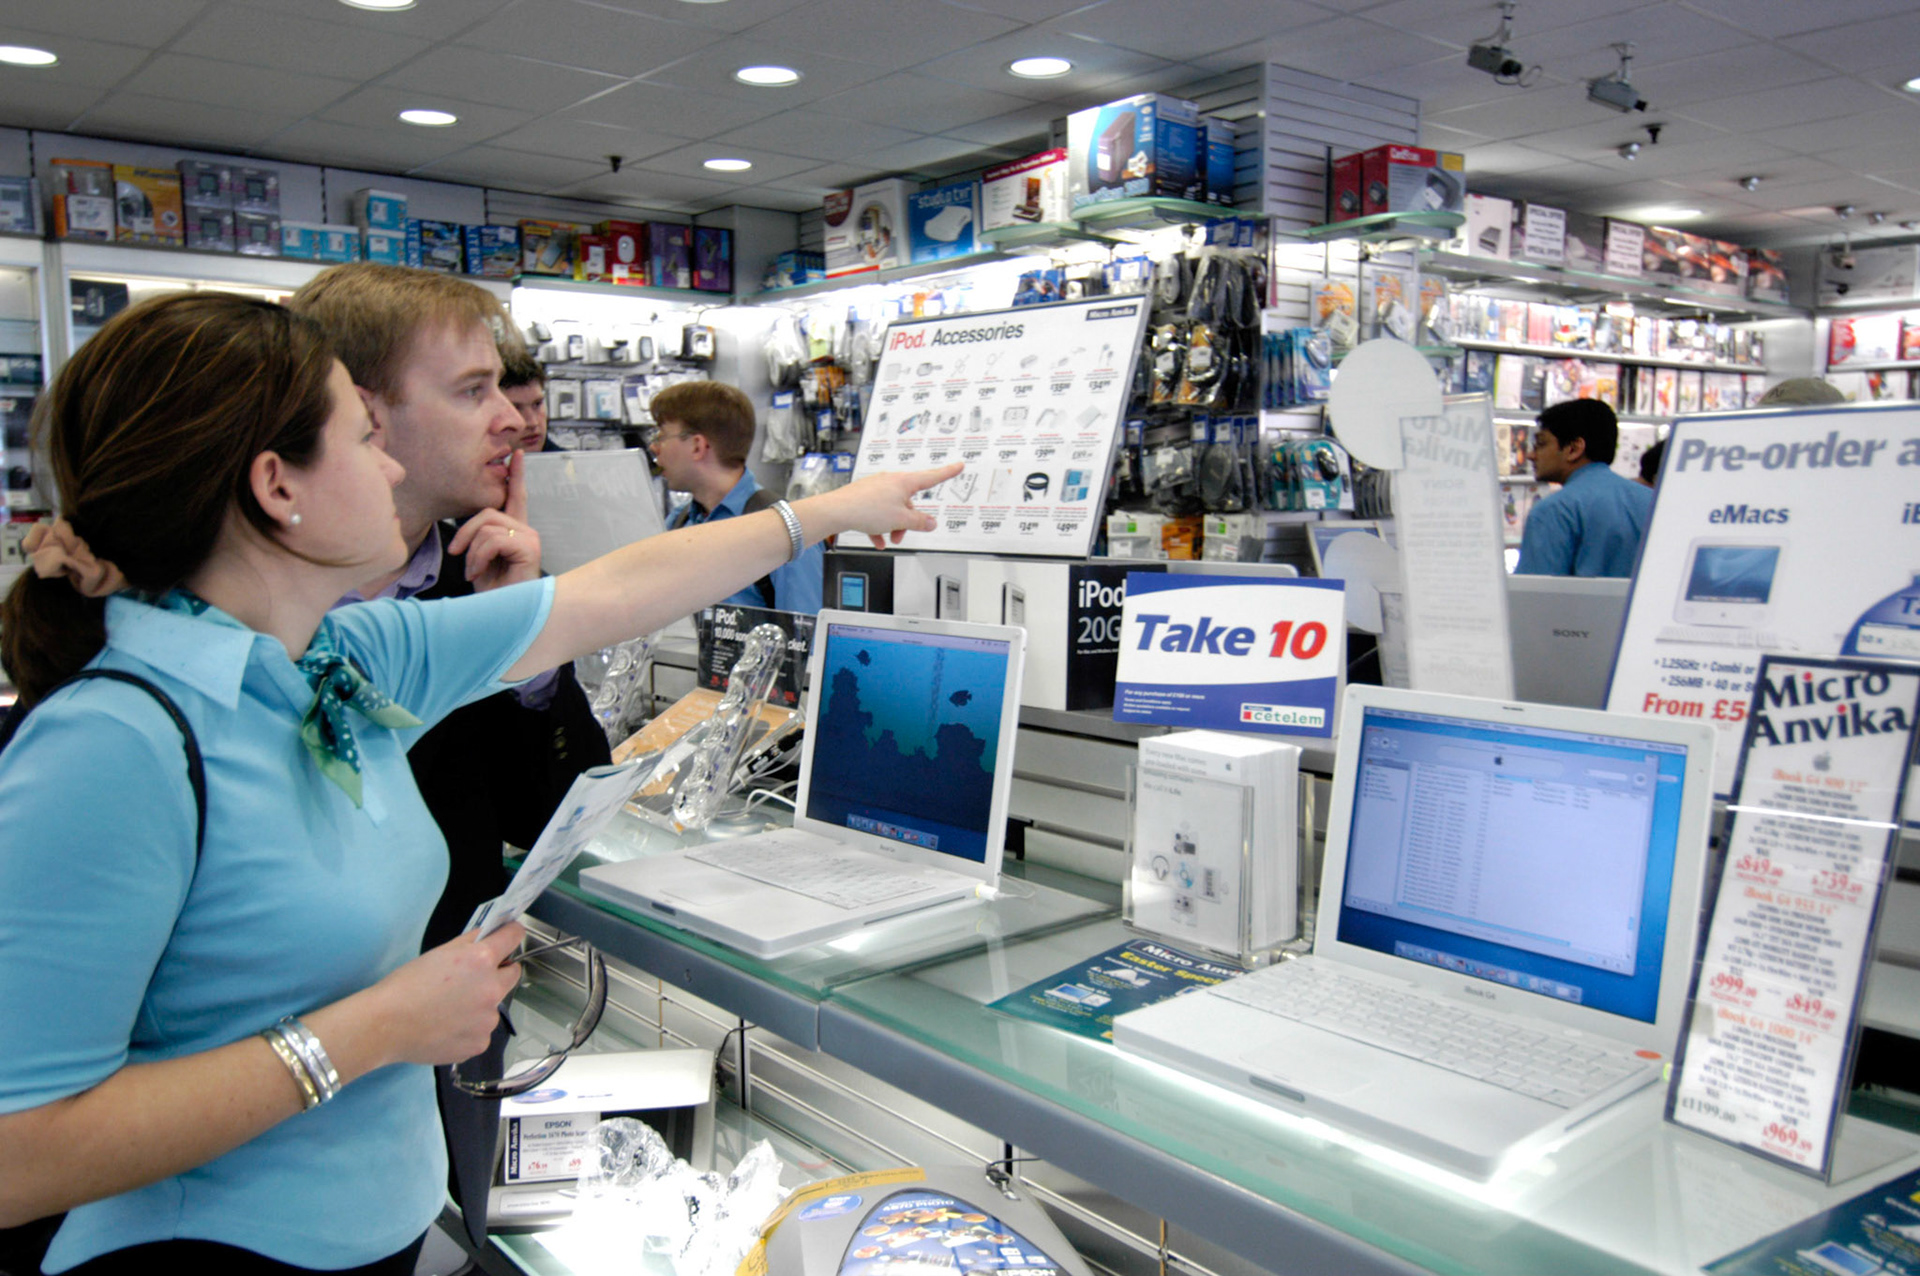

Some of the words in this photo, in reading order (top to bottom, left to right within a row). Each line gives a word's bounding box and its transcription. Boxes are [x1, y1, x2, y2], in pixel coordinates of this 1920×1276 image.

[889, 329, 926, 352] iPod.
[930, 321, 1024, 348] Accessories
[1675, 431, 1888, 472] Pre-order
[1708, 504, 1790, 525] eMacs
[1135, 613, 1257, 656] Take
[1268, 620, 1327, 661] 10
[1552, 627, 1590, 640] SONY
[1762, 669, 1890, 710] Micro
[1642, 692, 1703, 717] From
[1254, 711, 1322, 726] cetelem
[1748, 703, 1911, 749] Anvika
[1119, 952, 1174, 974] Easter
[1142, 945, 1193, 967] Micro
[544, 1120, 573, 1132] EPSON
